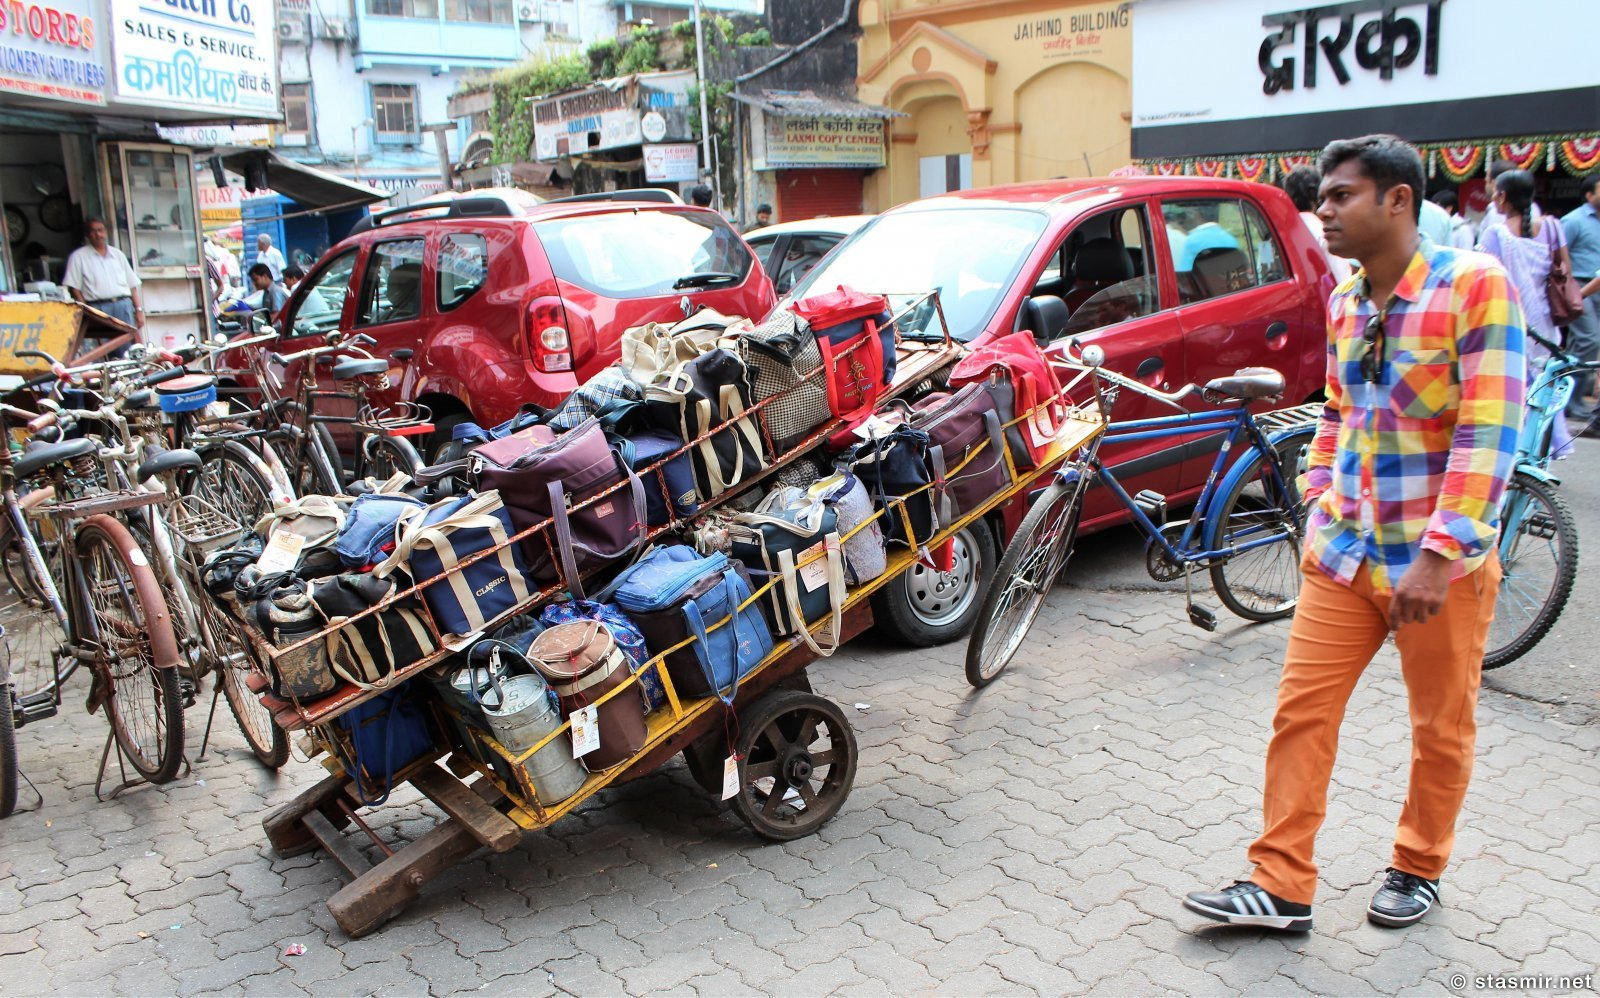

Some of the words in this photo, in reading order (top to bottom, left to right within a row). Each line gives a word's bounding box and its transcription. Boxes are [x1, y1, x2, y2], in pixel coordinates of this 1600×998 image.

[124, 19, 177, 44] SALES
[183, 31, 194, 47] &
[1014, 20, 1033, 41] JAI
[1036, 17, 1062, 38] HIND
[1070, 8, 1129, 34] BUILDING
[1258, 0, 1443, 96] द्वारका
[0, 46, 46, 77] IONERY
[49, 56, 106, 89] SUPPLIERS
[786, 134, 816, 143] LAXMI
[818, 134, 843, 144] COPY
[845, 135, 881, 145] CENTRE
[198, 186, 234, 204] VIJAY
[383, 178, 418, 191] VIJAY
[475, 575, 506, 597] CLASSIC
